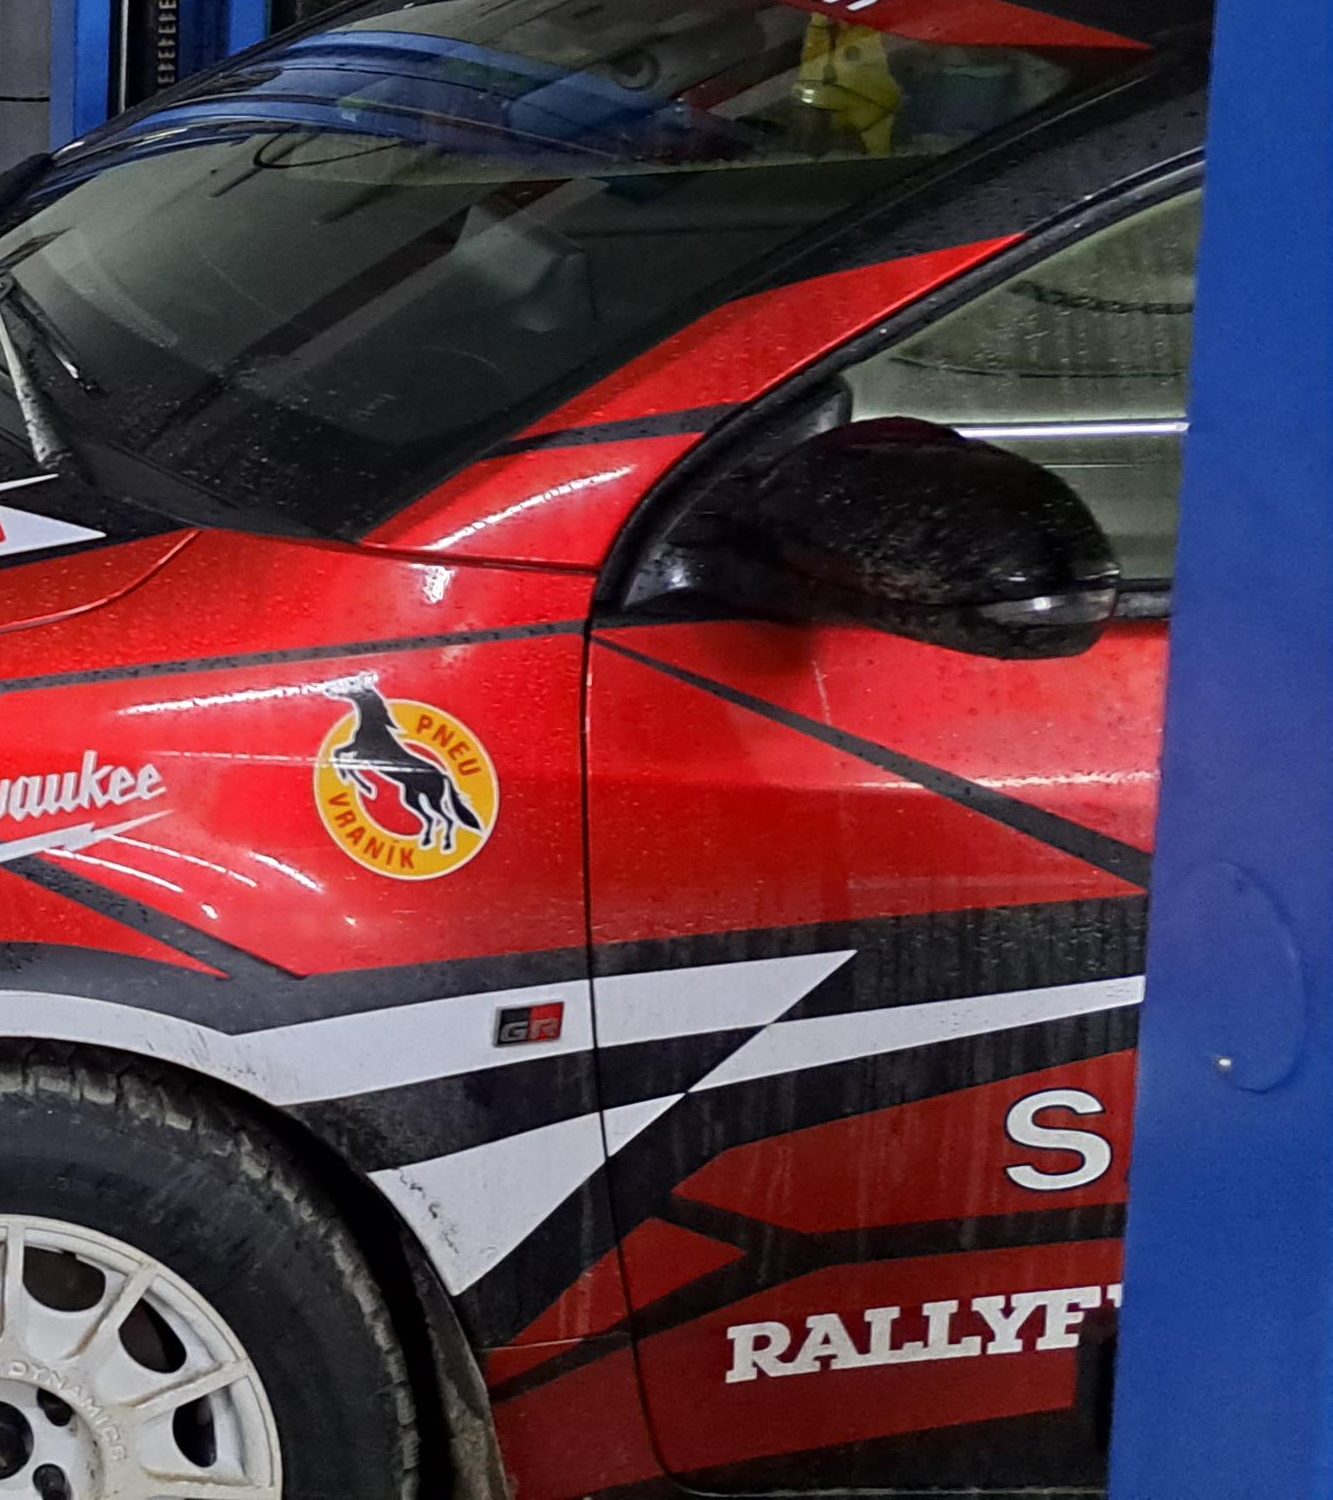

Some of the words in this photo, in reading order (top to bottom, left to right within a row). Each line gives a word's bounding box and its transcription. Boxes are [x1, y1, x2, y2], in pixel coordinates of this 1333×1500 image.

[416, 713, 482, 777] PNEU
[328, 792, 415, 870] VRANÍK
[499, 1017, 560, 1043] GR
[725, 1283, 1123, 1384] RALLYE
[7, 1360, 127, 1462] DYNAMICS
